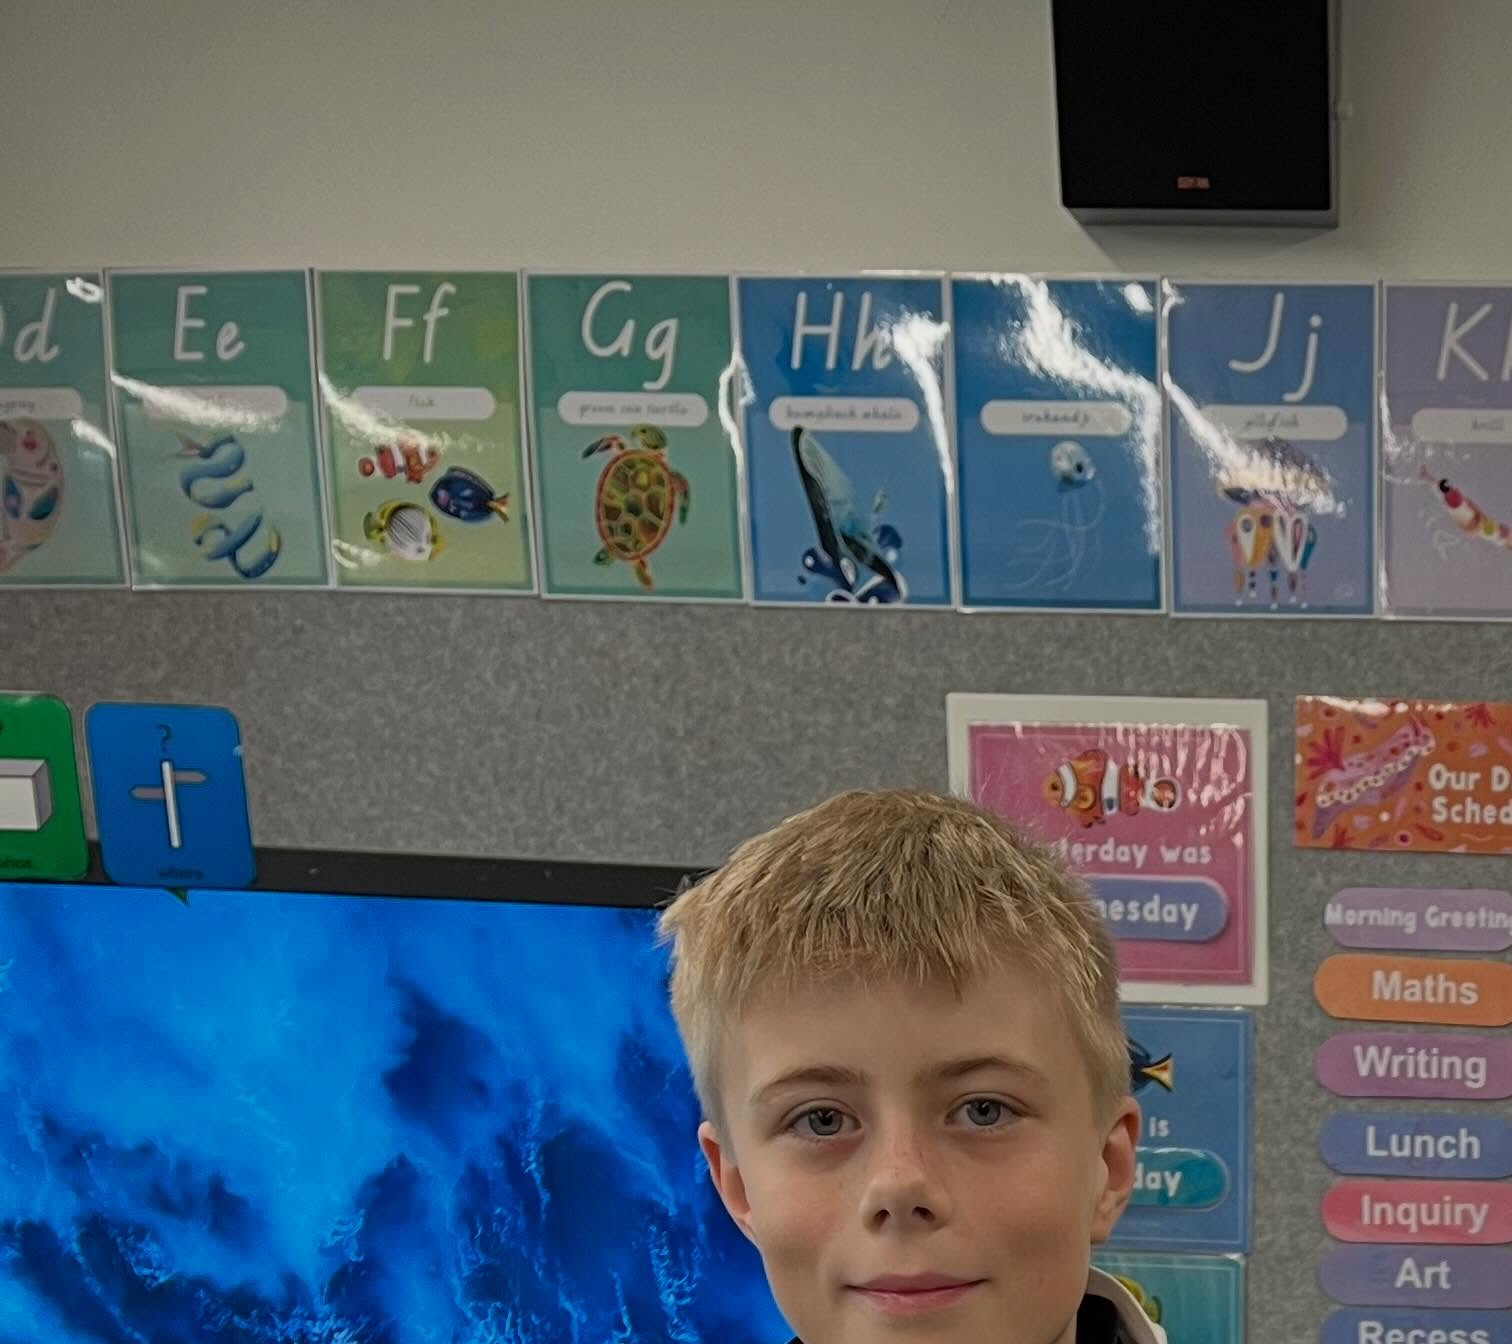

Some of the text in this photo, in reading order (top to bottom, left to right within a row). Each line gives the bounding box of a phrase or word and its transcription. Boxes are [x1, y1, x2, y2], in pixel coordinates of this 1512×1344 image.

[174, 285, 246, 361] Ee
[382, 282, 457, 363] Ff
[581, 281, 680, 391] Gg
[791, 291, 898, 371] Hh
[1229, 292, 1323, 401] Jj
[1429, 764, 1481, 791] Our
[1060, 837, 1212, 869] terday was
[1325, 903, 1417, 934] Morning
[1372, 970, 1480, 1005] Maths
[1353, 1045, 1488, 1089] Writing
[1149, 1117, 1170, 1138] is
[1365, 1125, 1481, 1160] Lunch
[1361, 1194, 1488, 1235] Inquiry
[1394, 1257, 1451, 1290] Art
